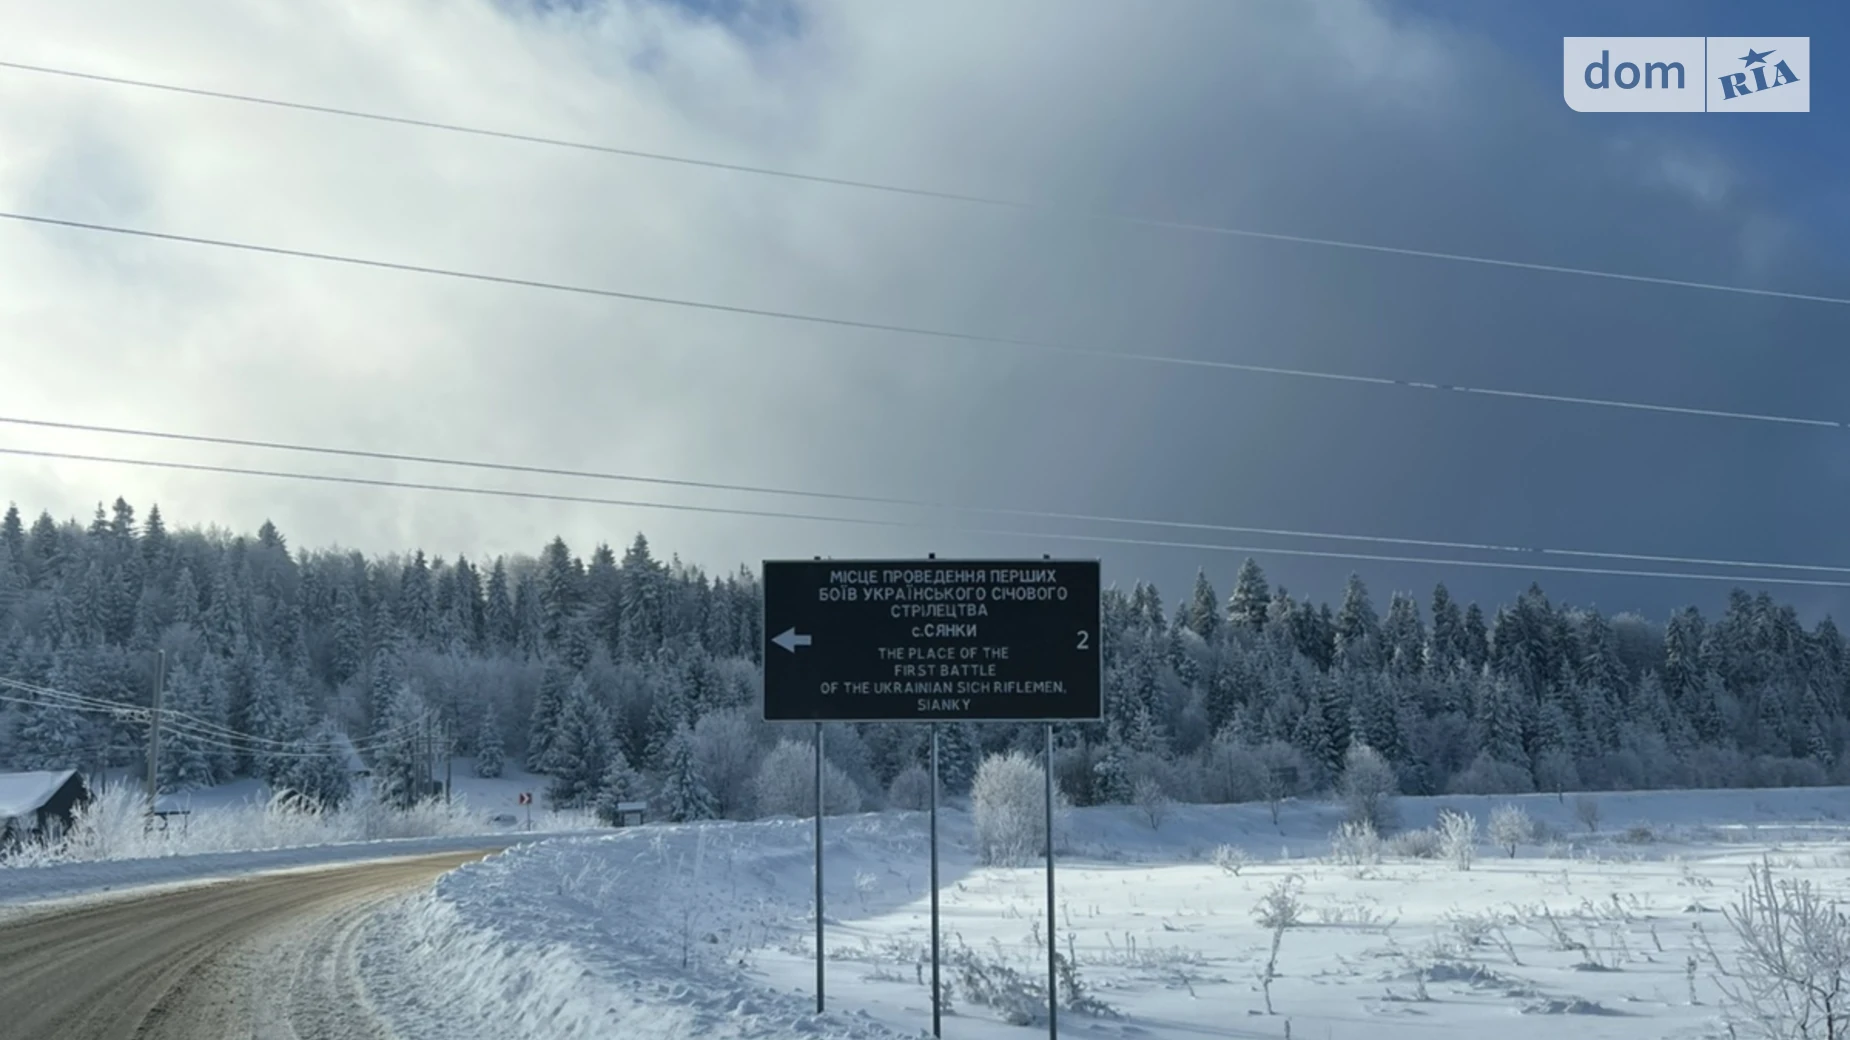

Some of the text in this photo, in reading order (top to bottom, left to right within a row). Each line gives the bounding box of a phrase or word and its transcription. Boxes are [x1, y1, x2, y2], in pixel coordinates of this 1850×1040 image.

[830, 570, 1057, 585] МІСЦЕ ПРОВЕДЕННЯ ПЕРШИХ
[819, 586, 1068, 601] БОЇВ УКРАЇНСЬКОГО СІЧОВОГО
[891, 603, 988, 618] СТРІЛЕЦТВА
[1076, 631, 1089, 649] 2
[878, 647, 1009, 660] THE PLACE OF THE
[894, 664, 996, 677] FIRST BATTLE
[820, 682, 840, 694] OF
[844, 682, 870, 694] THE
[873, 681, 952, 694] UKRAINIAN
[956, 681, 990, 694] SICH
[917, 698, 971, 711] SIANKY
